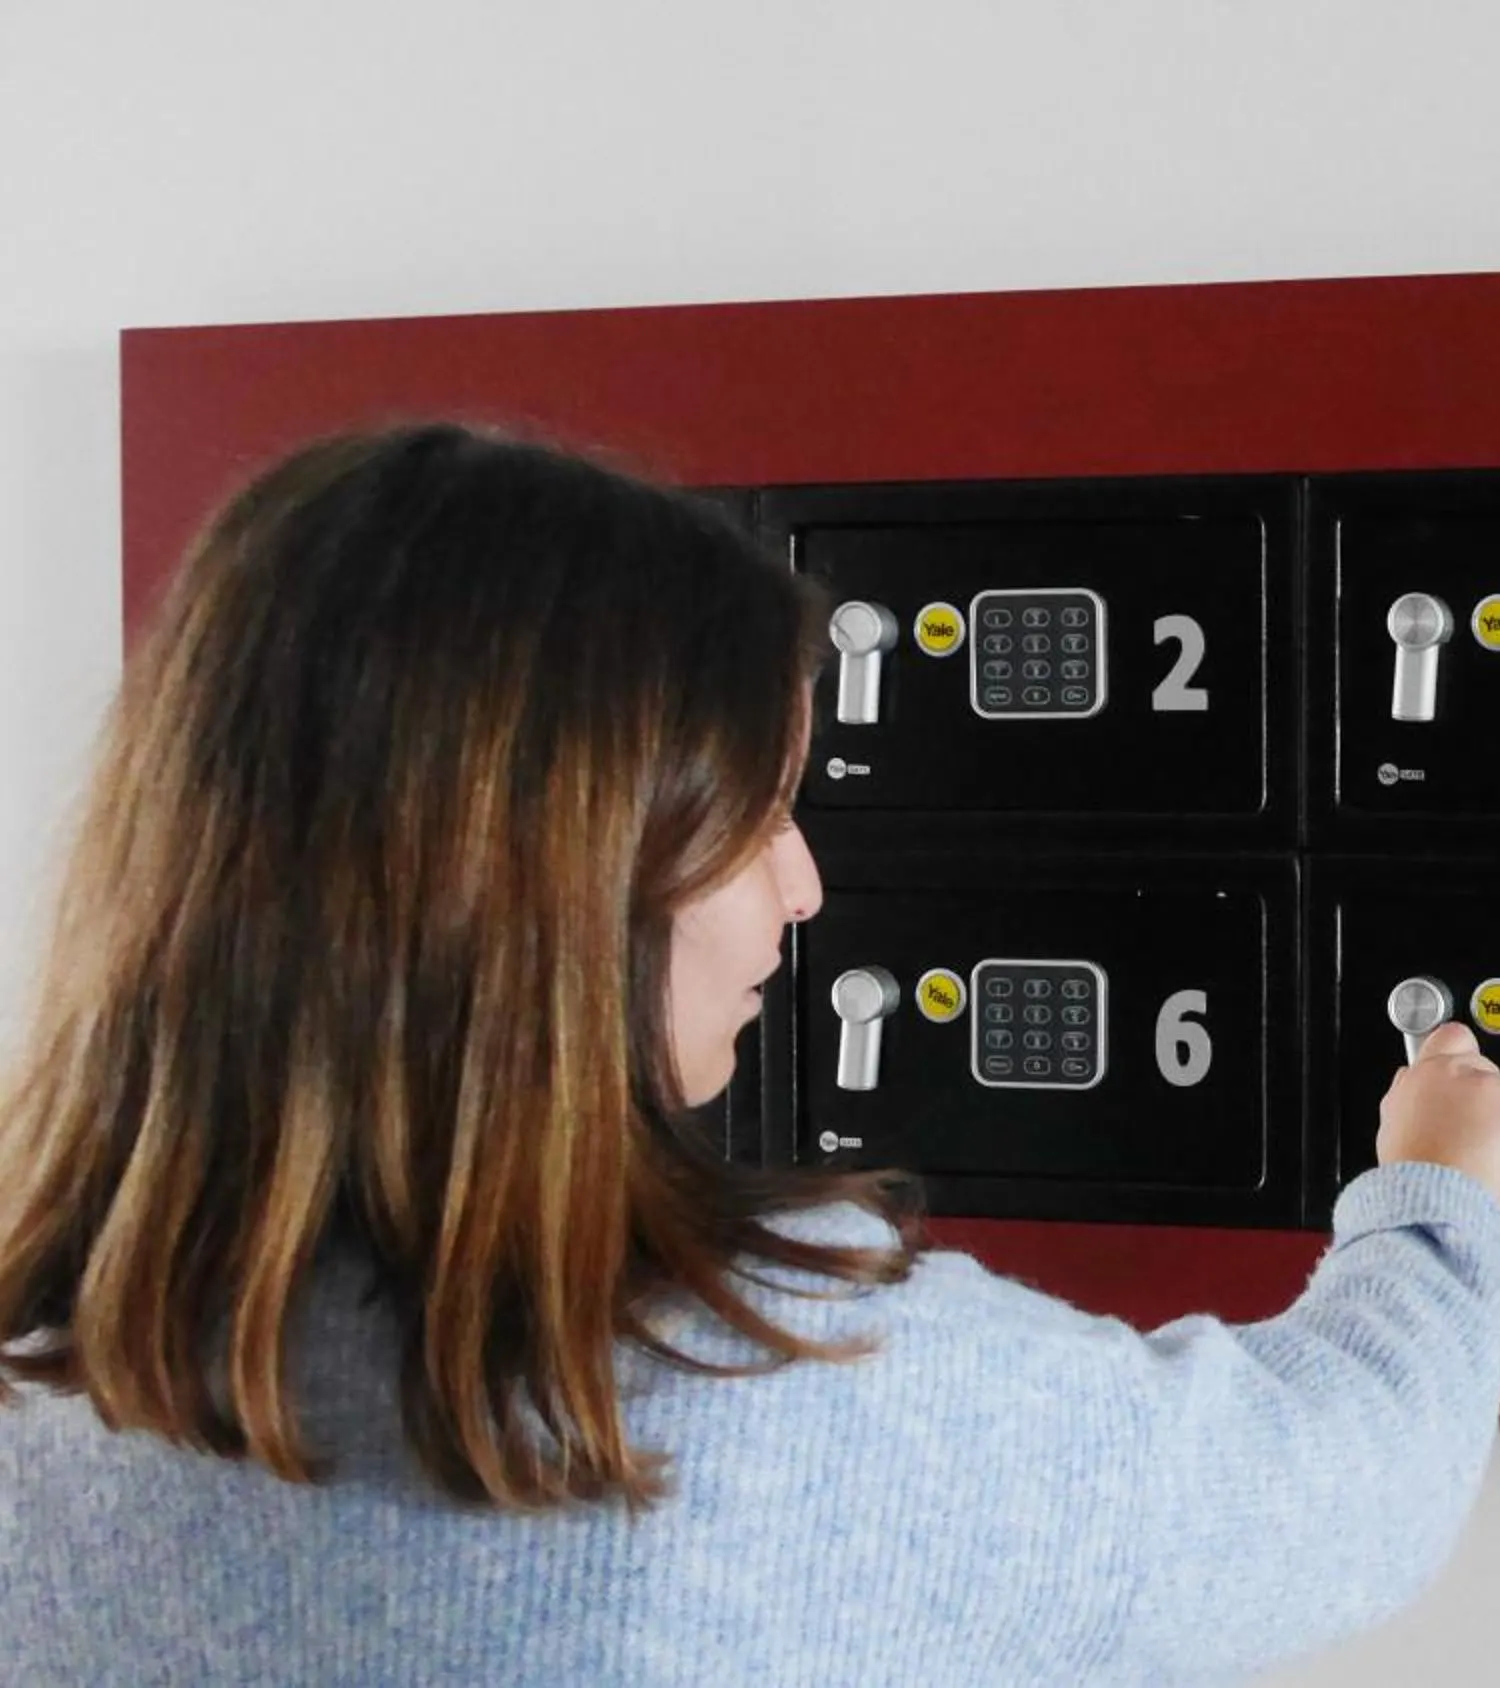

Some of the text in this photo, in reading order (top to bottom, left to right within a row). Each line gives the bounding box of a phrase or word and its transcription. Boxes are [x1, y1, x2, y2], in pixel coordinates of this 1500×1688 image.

[923, 623, 955, 638] Yale
[1152, 615, 1208, 711] 2
[927, 983, 955, 1009] Yale
[1156, 989, 1212, 1087] 6
